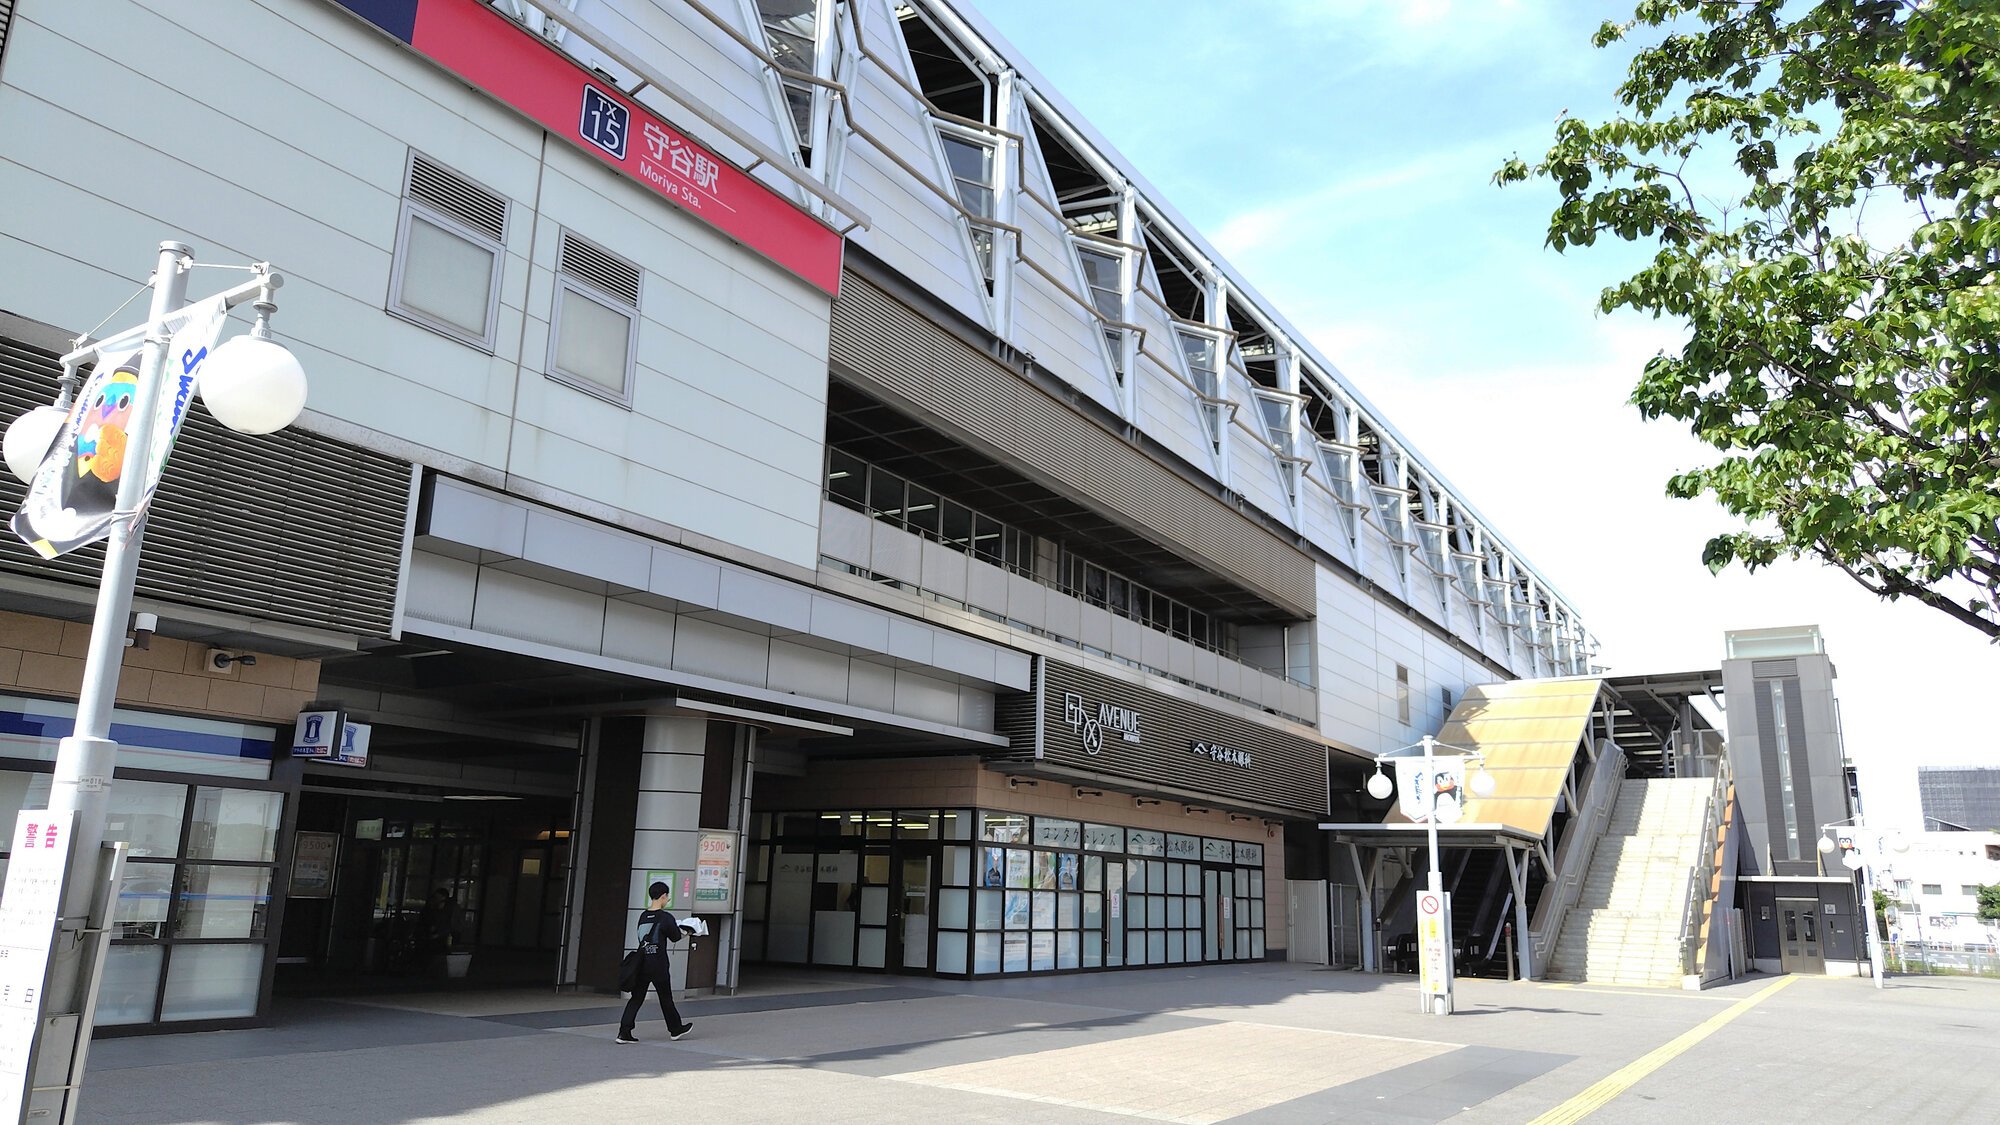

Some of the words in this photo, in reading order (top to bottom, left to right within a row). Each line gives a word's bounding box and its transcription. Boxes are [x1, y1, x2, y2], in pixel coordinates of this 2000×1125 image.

[596, 96, 617, 121] TX
[590, 110, 621, 150] 15
[643, 121, 720, 195] 守谷駅
[639, 160, 678, 195] Moriya
[681, 187, 702, 209] Sta.
[1098, 702, 1140, 733] AVENUE
